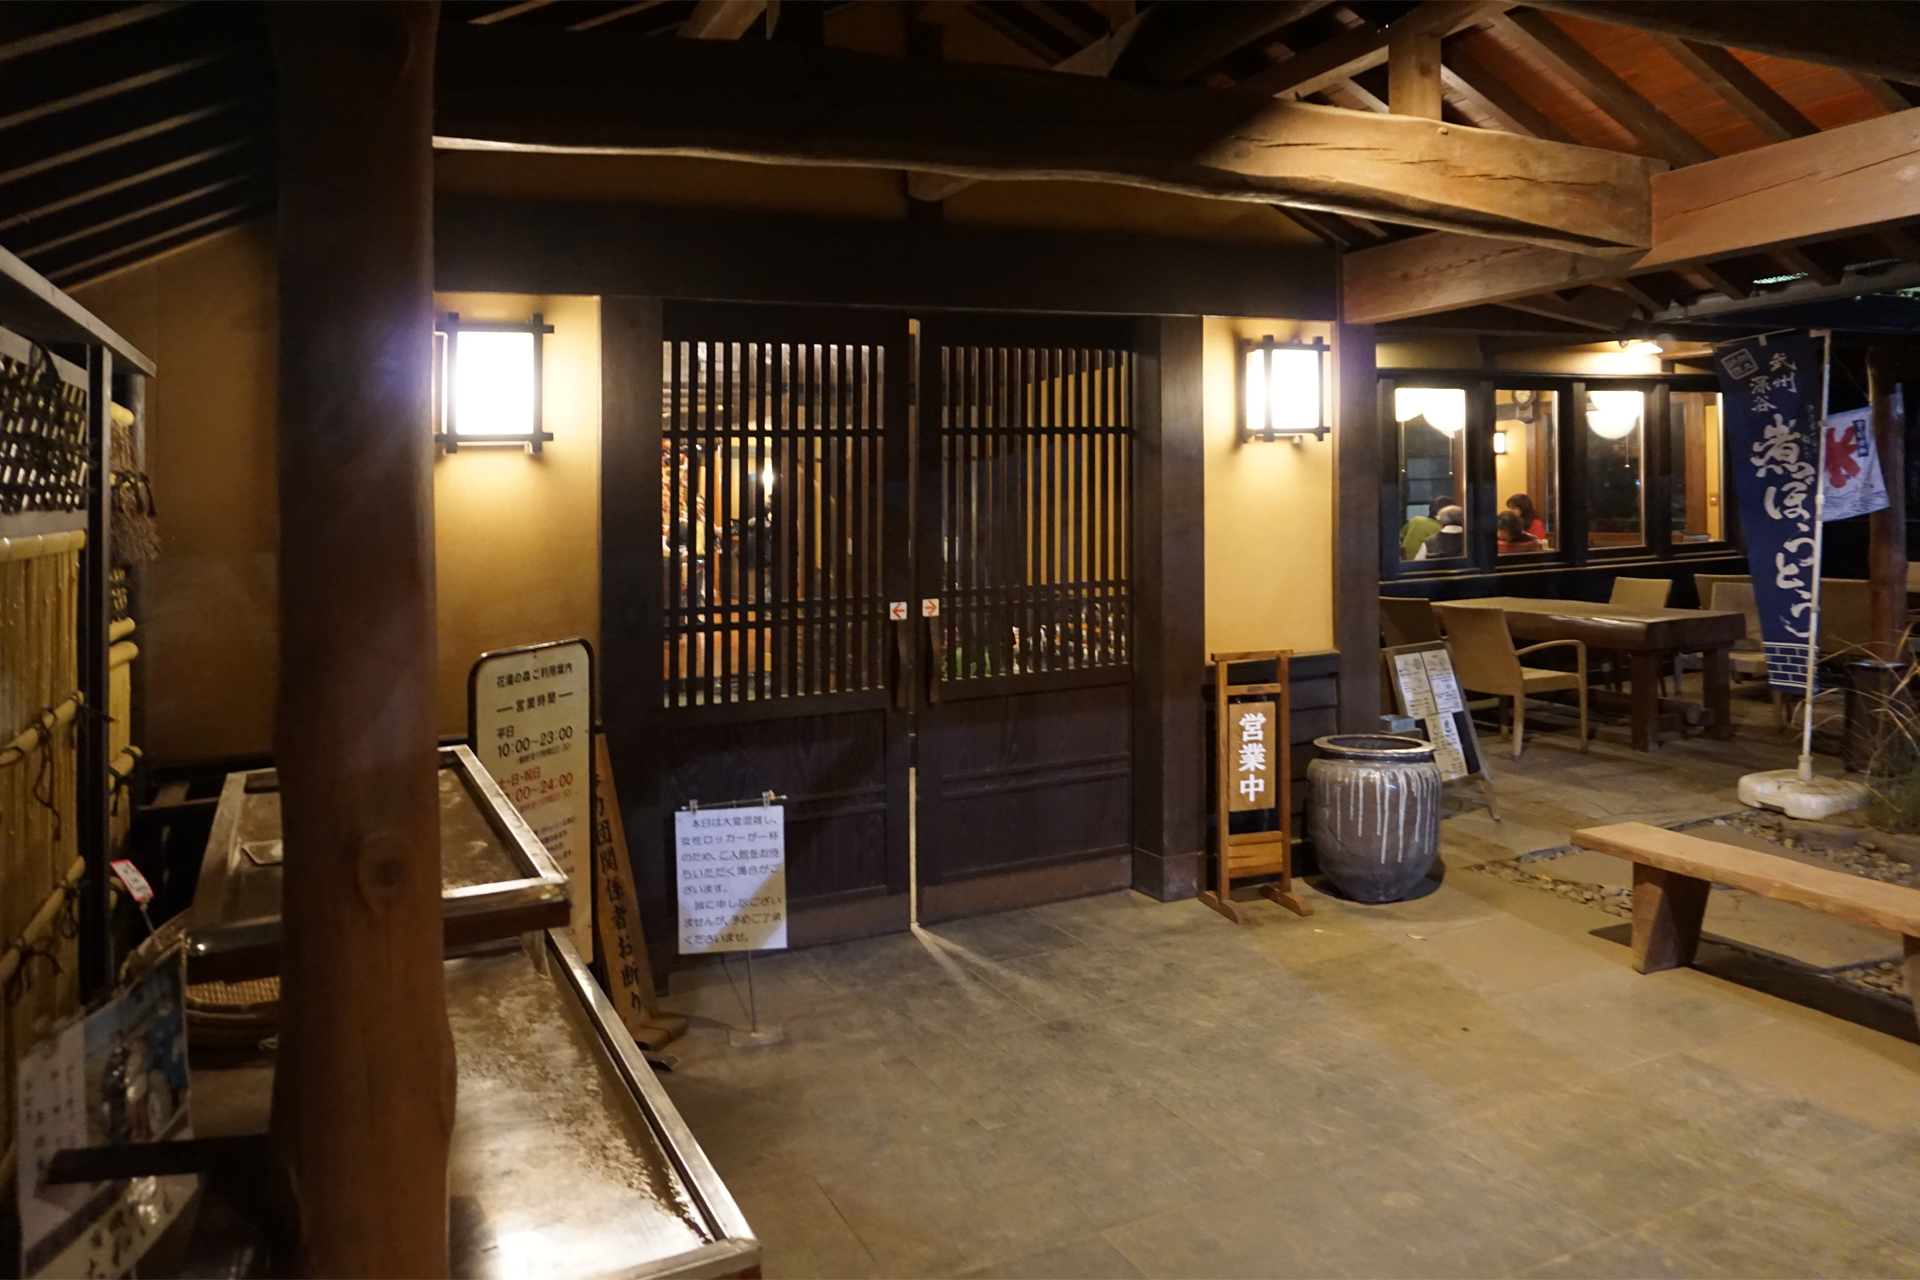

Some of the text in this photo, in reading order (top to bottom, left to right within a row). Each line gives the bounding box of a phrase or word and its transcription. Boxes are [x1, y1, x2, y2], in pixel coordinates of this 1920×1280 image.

[1768, 352, 1798, 393] 武州
[1750, 375, 1777, 412] 深谷
[496, 662, 573, 688] 花湯の森 ご利用案内
[515, 691, 557, 713] 営業時間
[496, 725, 514, 740] 平日
[497, 725, 573, 758] 10:00～23:00
[1238, 712, 1267, 803] 営業中
[682, 884, 728, 895] ざいます。
[685, 932, 749, 945] くださいませ。
